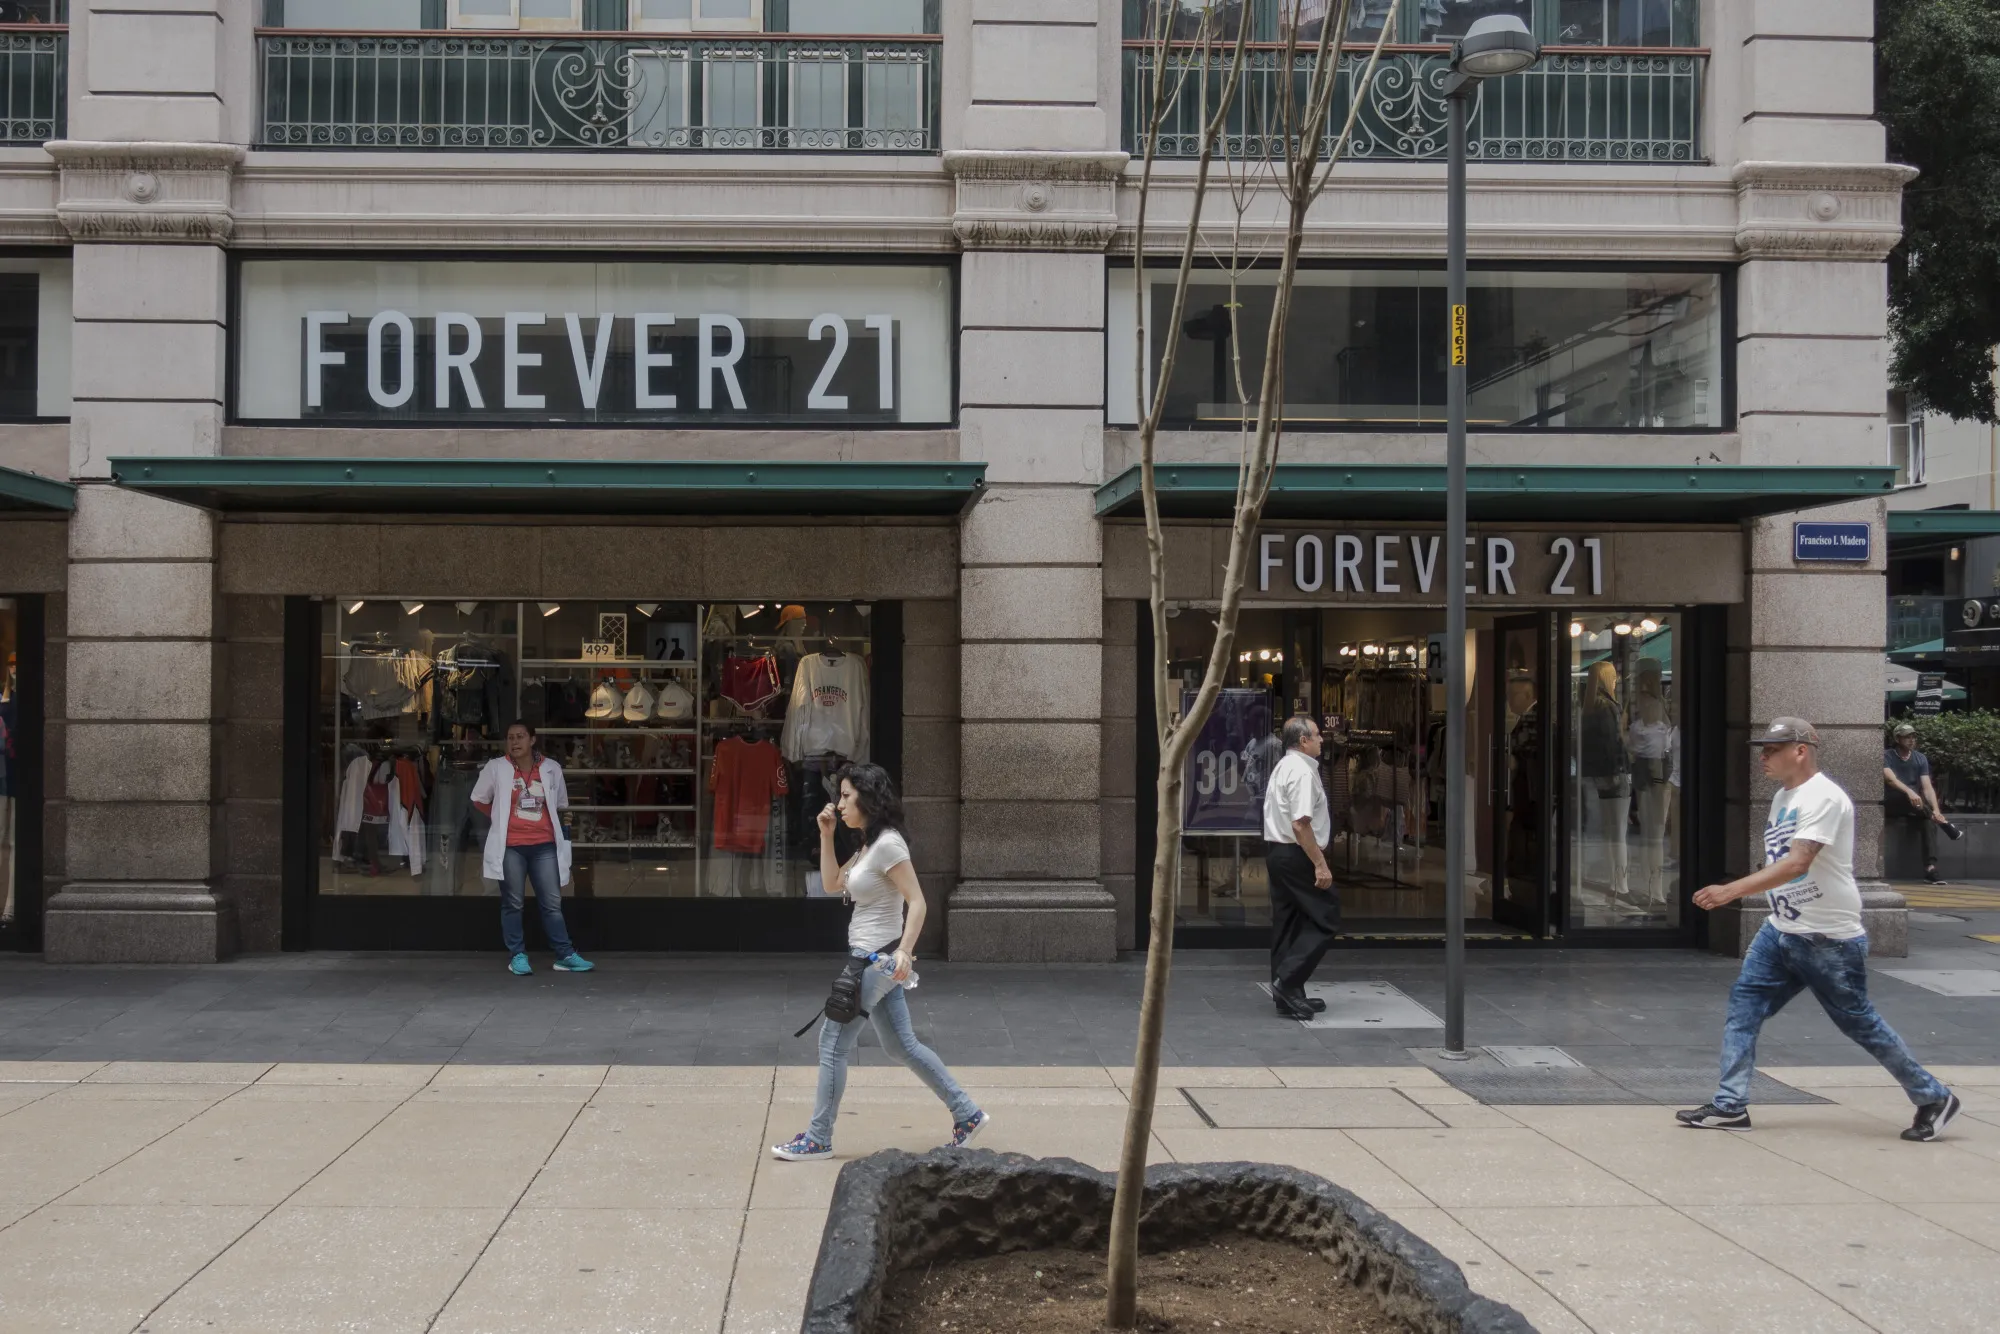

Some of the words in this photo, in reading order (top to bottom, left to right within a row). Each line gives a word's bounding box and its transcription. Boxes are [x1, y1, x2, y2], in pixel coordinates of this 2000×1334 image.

[1455, 306, 1465, 365] 051612
[306, 310, 748, 410] FOREVER
[807, 312, 893, 410] 21
[1800, 535, 1832, 546] Francisco
[1833, 535, 1839, 546] I.
[1840, 535, 1866, 546] Madero
[1550, 537, 1602, 595] 21
[1324, 715, 1340, 728] 30%
[1786, 885, 1819, 900] STRIPES
